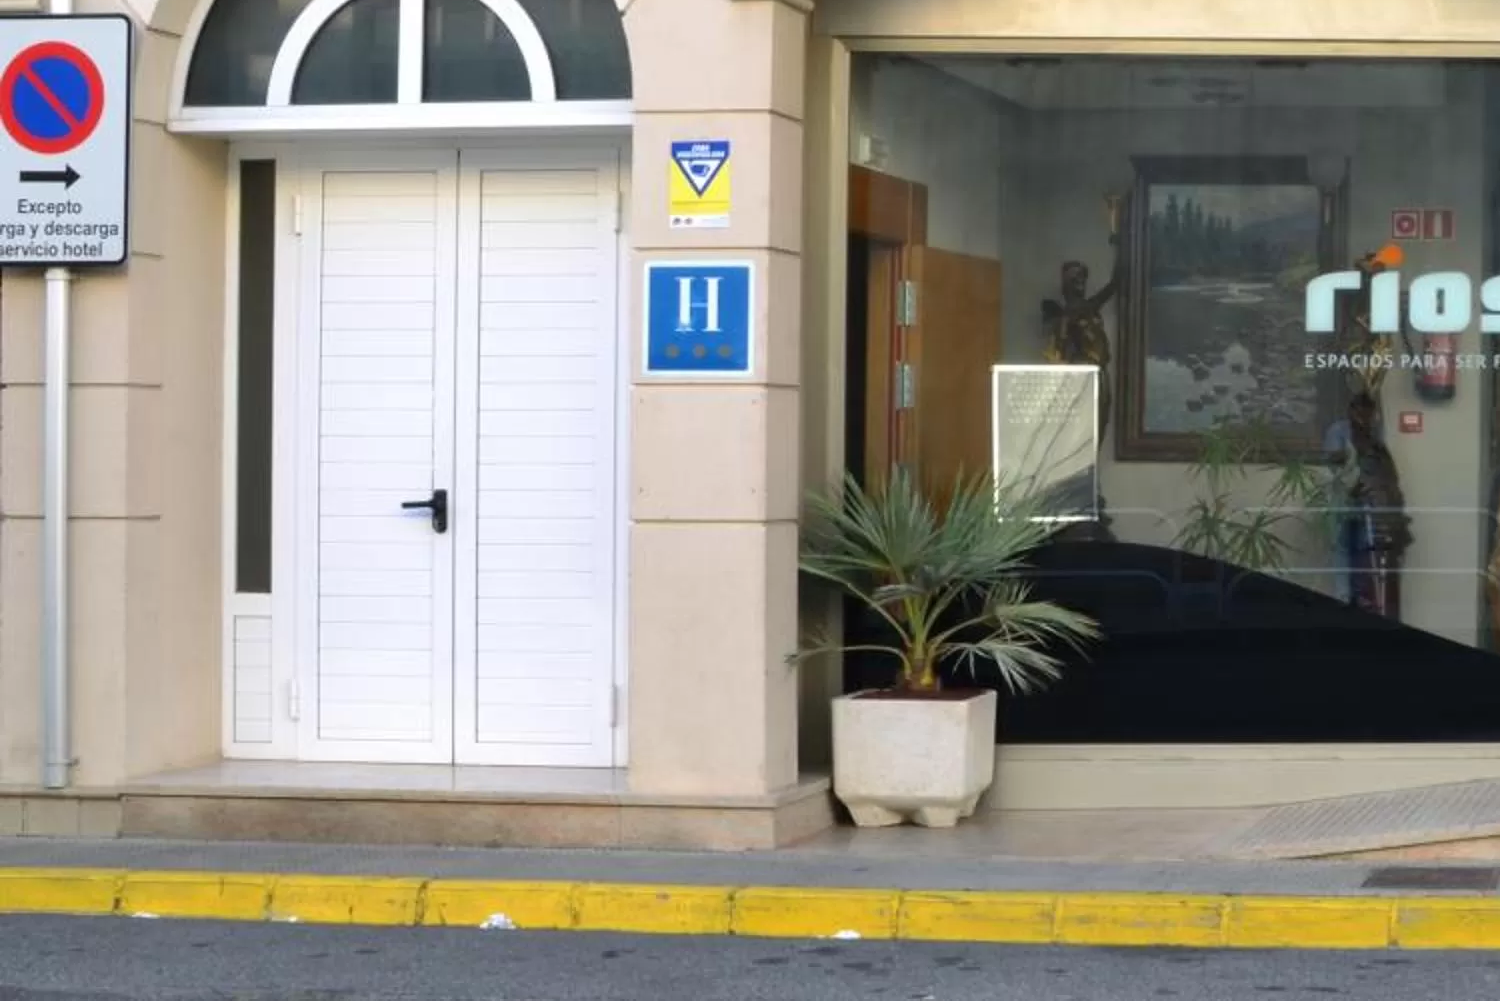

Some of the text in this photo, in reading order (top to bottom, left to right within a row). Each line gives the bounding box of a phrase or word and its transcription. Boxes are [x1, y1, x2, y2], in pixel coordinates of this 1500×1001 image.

[17, 198, 82, 217] Excepto
[0, 220, 119, 239] rga y descarga
[63, 241, 103, 257] hotel
[674, 276, 724, 332] H
[1304, 353, 1393, 369] ESPACIOS
[1401, 353, 1448, 369] PARA
[1455, 353, 1487, 369] SER
